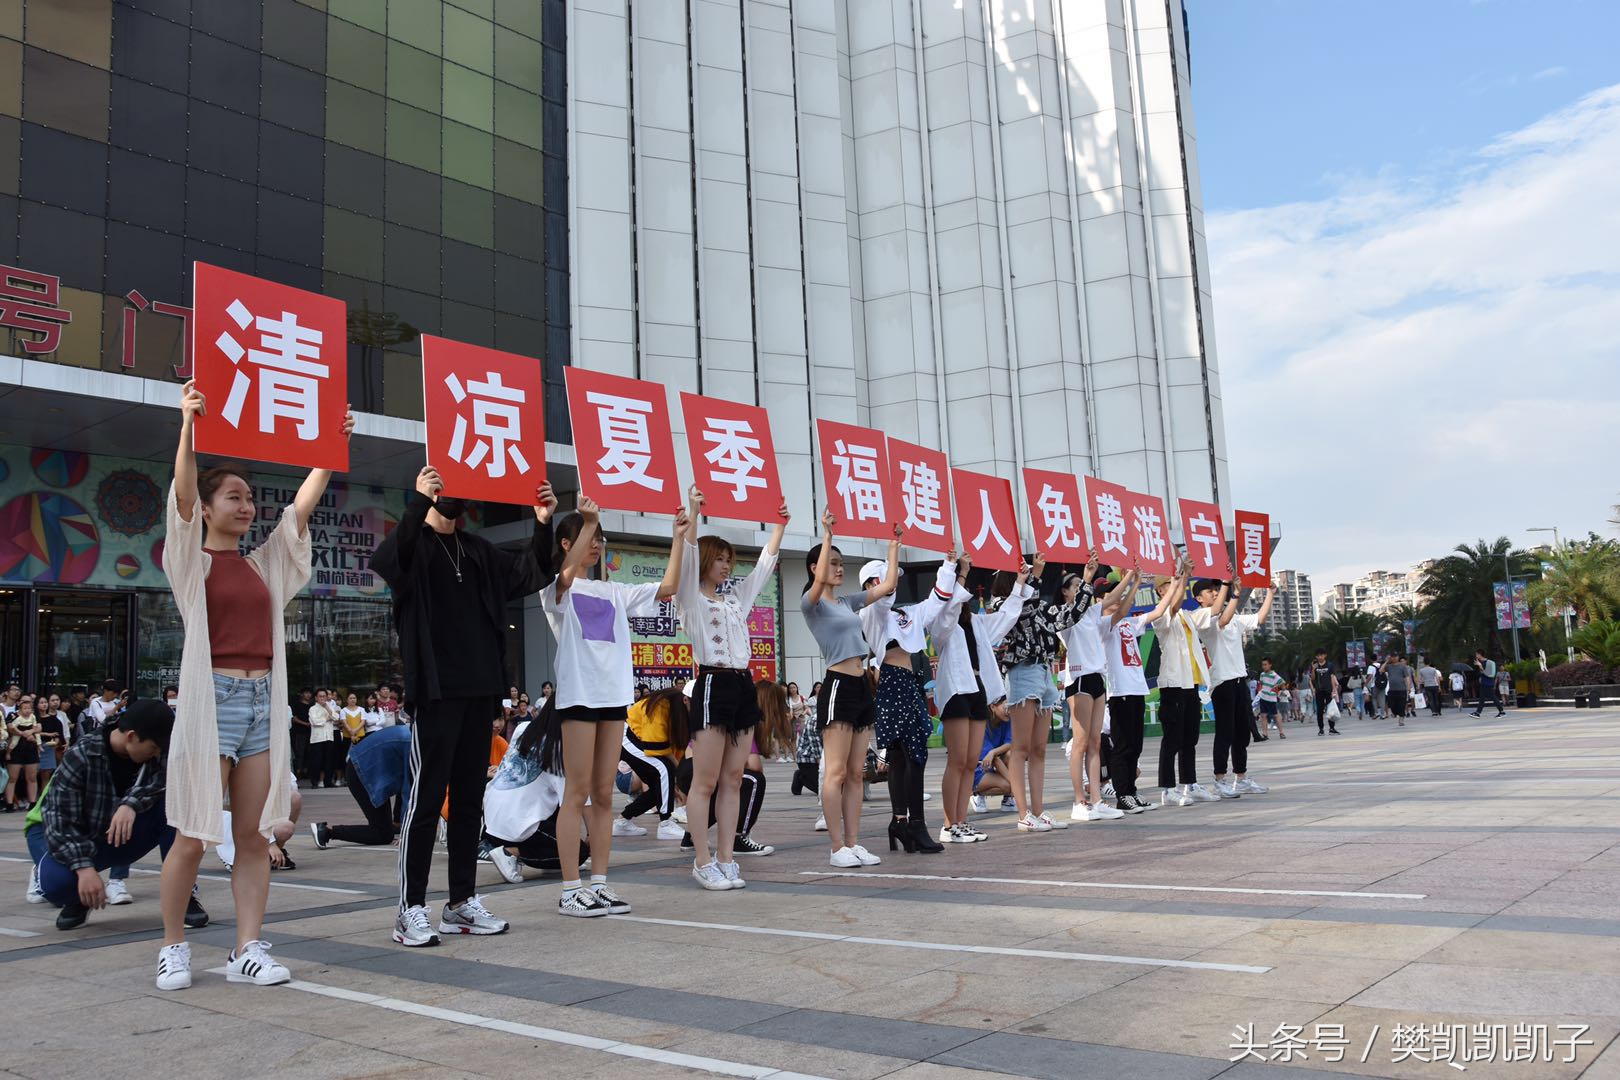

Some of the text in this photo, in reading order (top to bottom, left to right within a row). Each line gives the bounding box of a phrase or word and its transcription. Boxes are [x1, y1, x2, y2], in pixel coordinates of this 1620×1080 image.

[215, 298, 330, 441] 清
[444, 371, 530, 478] 凉
[586, 391, 664, 493] 夏
[702, 416, 768, 502] 季
[831, 439, 887, 523] 福
[261, 488, 336, 508] FUZU
[899, 461, 946, 536] 建
[972, 488, 1013, 556] 人
[1036, 482, 1081, 549] 免
[1095, 492, 1129, 556] 费
[1132, 505, 1166, 564] 游
[1189, 512, 1220, 567] 宁
[1241, 522, 1266, 576] 夏
[316, 570, 374, 588] 时尚造物
